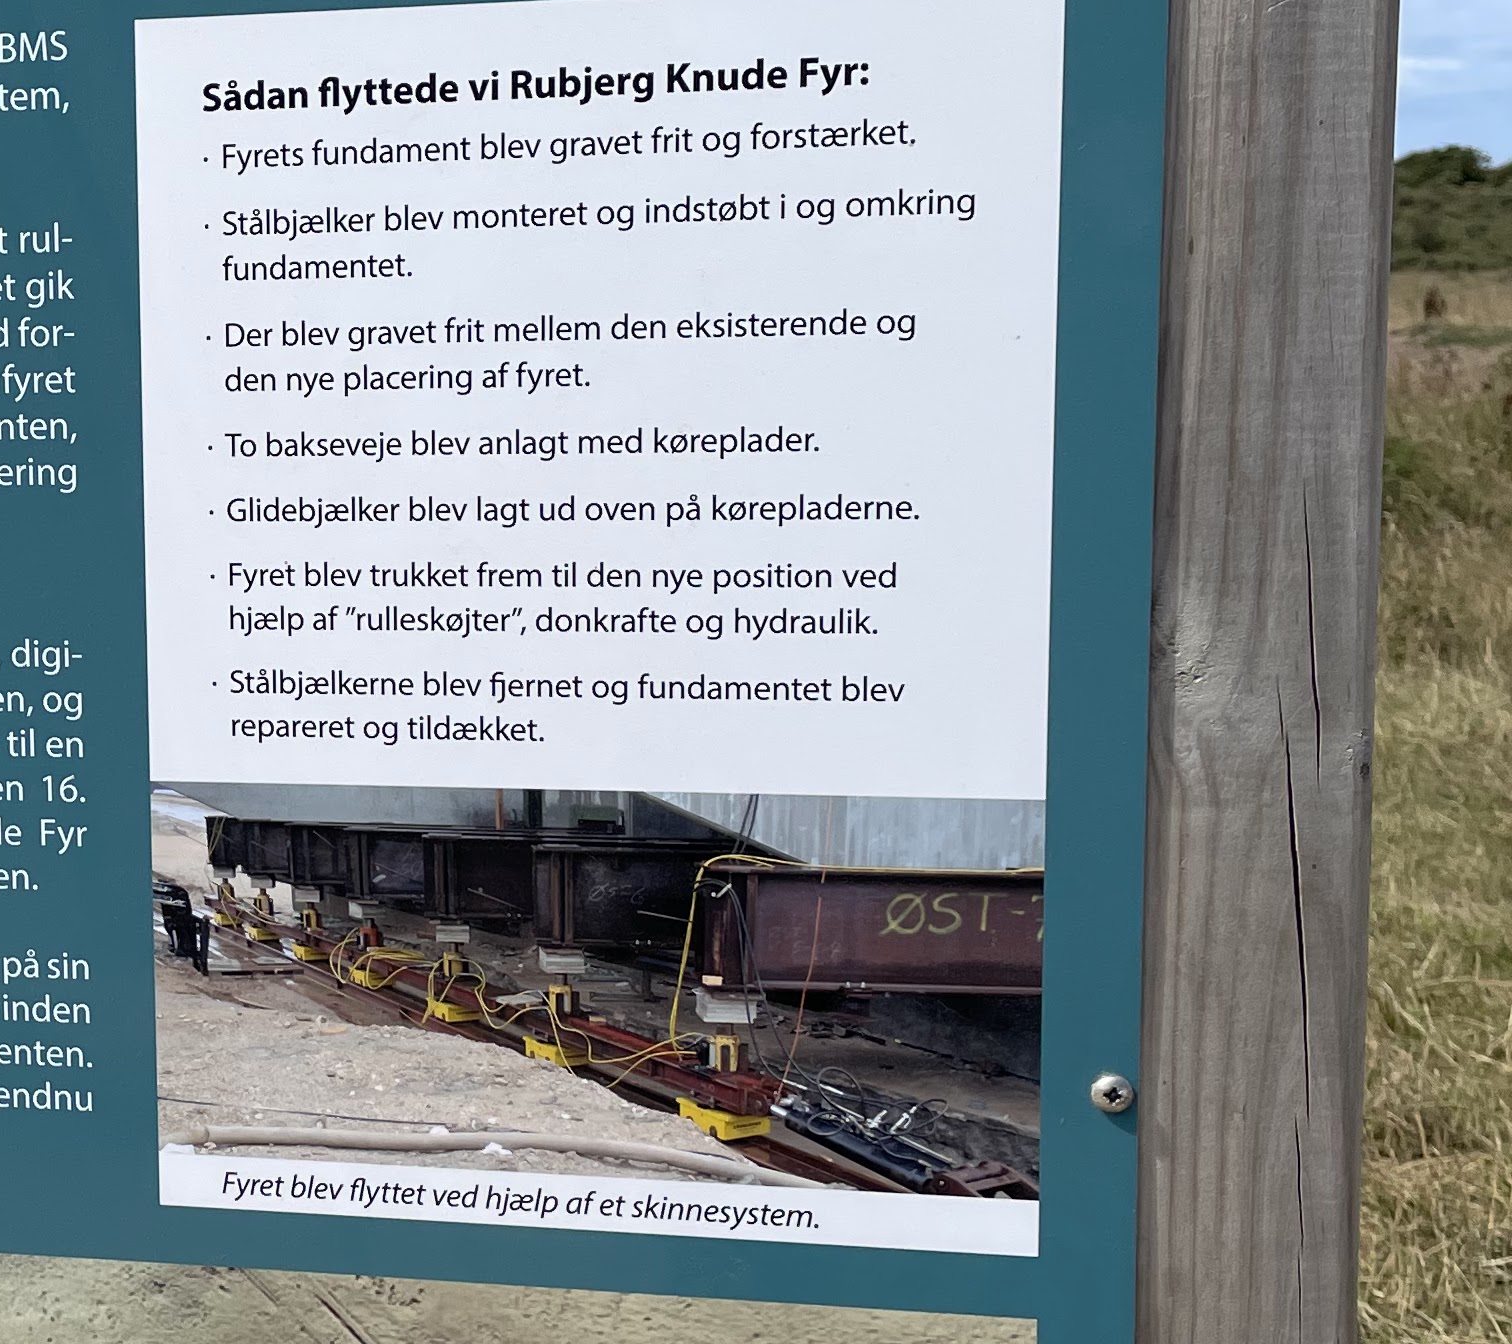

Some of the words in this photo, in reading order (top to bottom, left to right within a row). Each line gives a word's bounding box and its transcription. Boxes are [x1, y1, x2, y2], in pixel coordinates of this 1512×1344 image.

[202, 79, 309, 112] Sådan
[317, 72, 459, 116] flyttede
[468, 70, 499, 102] vi
[510, 66, 655, 106] Rubjerg
[666, 57, 788, 94] Knude
[799, 57, 869, 96] Fyr:
[222, 143, 304, 176] Fyrets
[311, 137, 471, 166] fundament
[480, 132, 541, 160] blev
[549, 130, 643, 165] gravet
[650, 125, 693, 154] frit
[702, 131, 741, 159] og
[750, 118, 916, 150] forstærket.
[17, 316, 75, 347] for-
[224, 433, 257, 458] To
[266, 430, 402, 463] bakseveje
[411, 429, 471, 456] blev
[478, 428, 569, 462] anlagt
[578, 427, 643, 455] med
[653, 425, 820, 460] køreplader.
[226, 496, 400, 529] Glidebjælker
[409, 495, 468, 522] blev
[477, 495, 530, 529] lagt
[539, 494, 575, 522] ud
[585, 502, 655, 521] oven
[666, 493, 701, 528] på
[712, 493, 920, 527] kørepladerne.
[229, 562, 296, 594] Fyret
[304, 561, 362, 587] blev
[369, 561, 469, 587] trukket
[476, 561, 542, 588] frem
[551, 561, 577, 588] til
[586, 561, 641, 588] den
[652, 569, 703, 595] nye
[713, 563, 832, 595] position
[841, 561, 897, 589] ved
[230, 668, 414, 701] Stålbjælkerne
[423, 670, 482, 697] blev
[489, 671, 583, 704] fjernet
[591, 680, 628, 706] og
[637, 672, 833, 702] fundamentet
[842, 675, 906, 702] blev
[231, 716, 355, 744] repareret
[363, 721, 398, 746] og
[406, 714, 545, 742] tildækket.
[40, 818, 88, 855] Fyr
[221, 1170, 285, 1202] Fyret
[290, 1173, 344, 1201] blev
[349, 1176, 427, 1209] flyttet
[432, 1184, 480, 1209] ved
[485, 1184, 560, 1219] hjælp
[565, 1190, 598, 1216] af
[599, 1194, 626, 1218] et
[631, 1193, 821, 1232] skinnesystem.
